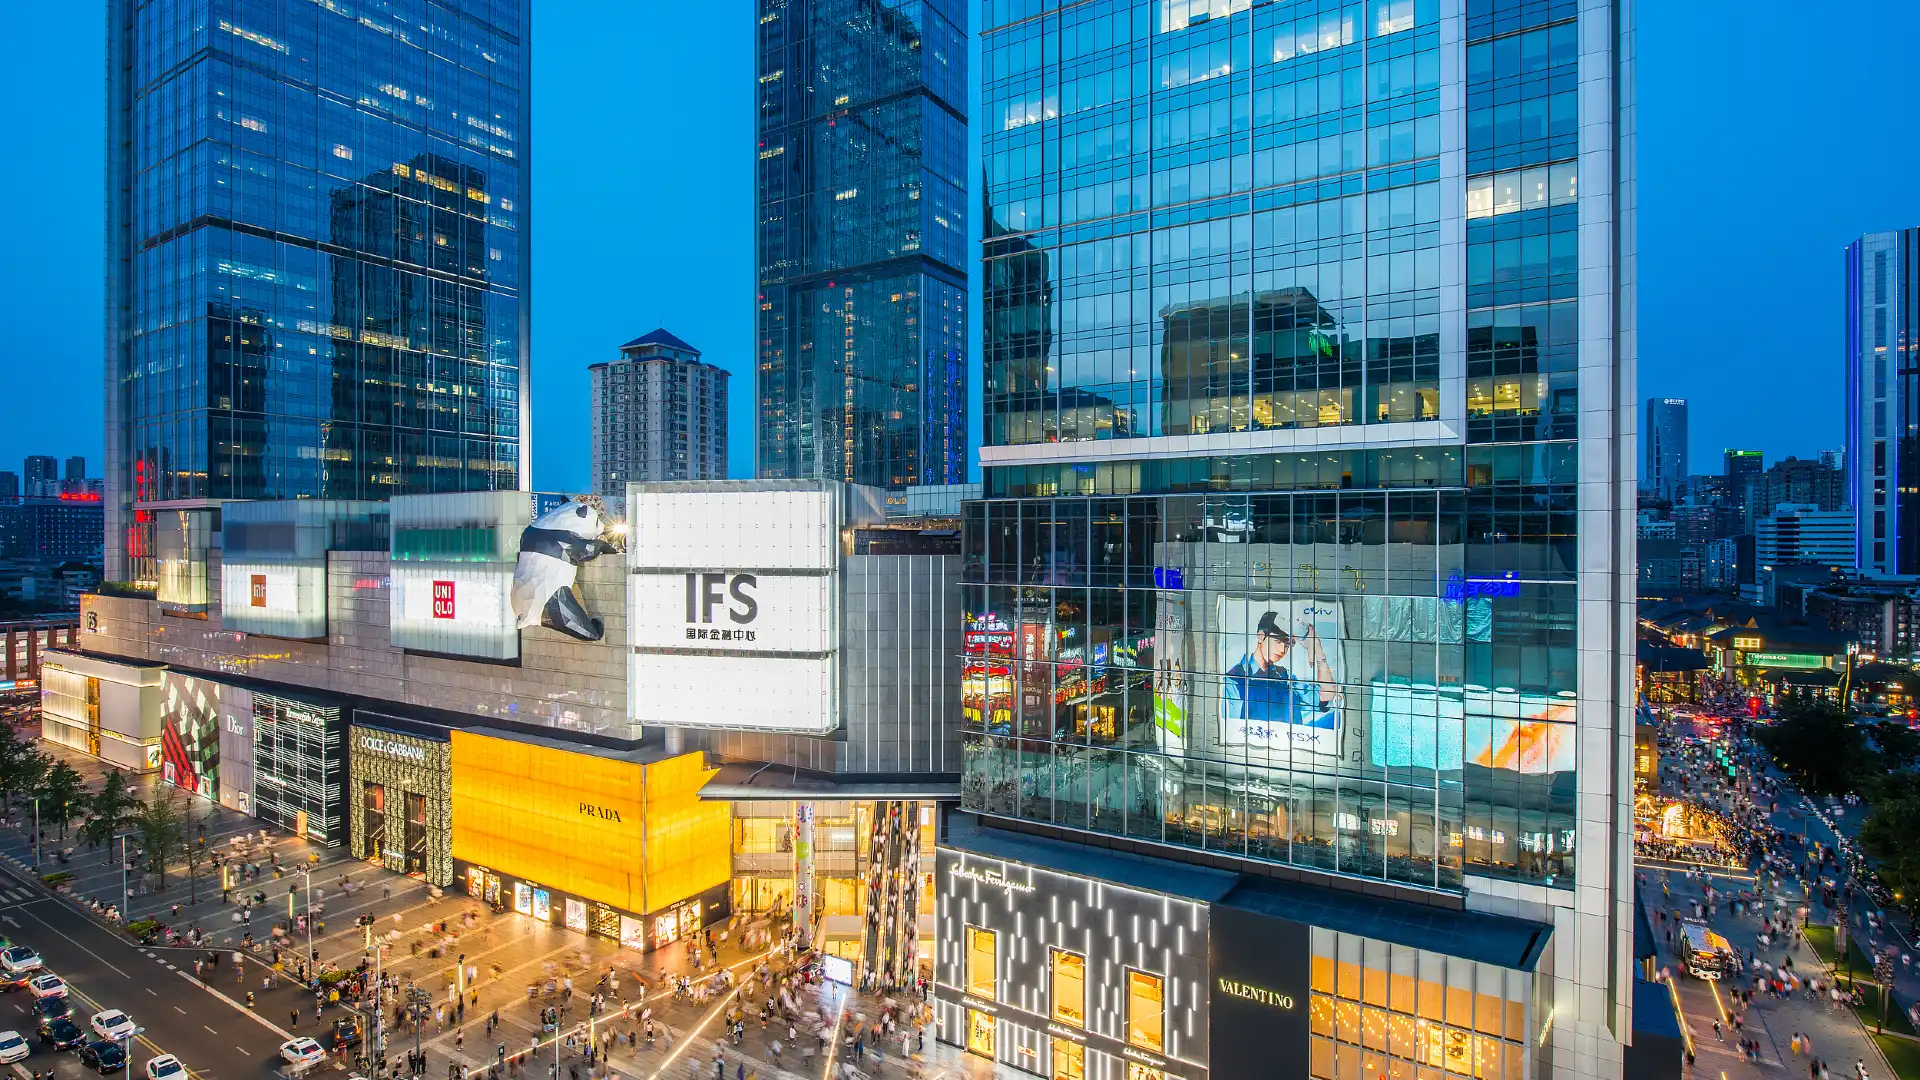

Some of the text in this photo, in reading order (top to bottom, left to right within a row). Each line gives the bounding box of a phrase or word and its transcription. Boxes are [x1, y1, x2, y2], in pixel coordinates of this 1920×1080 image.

[435, 585, 451, 598] UNI
[685, 573, 758, 624] IFS
[435, 601, 452, 615] QLO
[686, 628, 756, 641] 国际金融中心
[227, 715, 244, 735] Dior
[580, 802, 621, 823] PRADA
[985, 869, 1036, 895] Ferragamo
[1219, 978, 1293, 1009] VALENTINO
